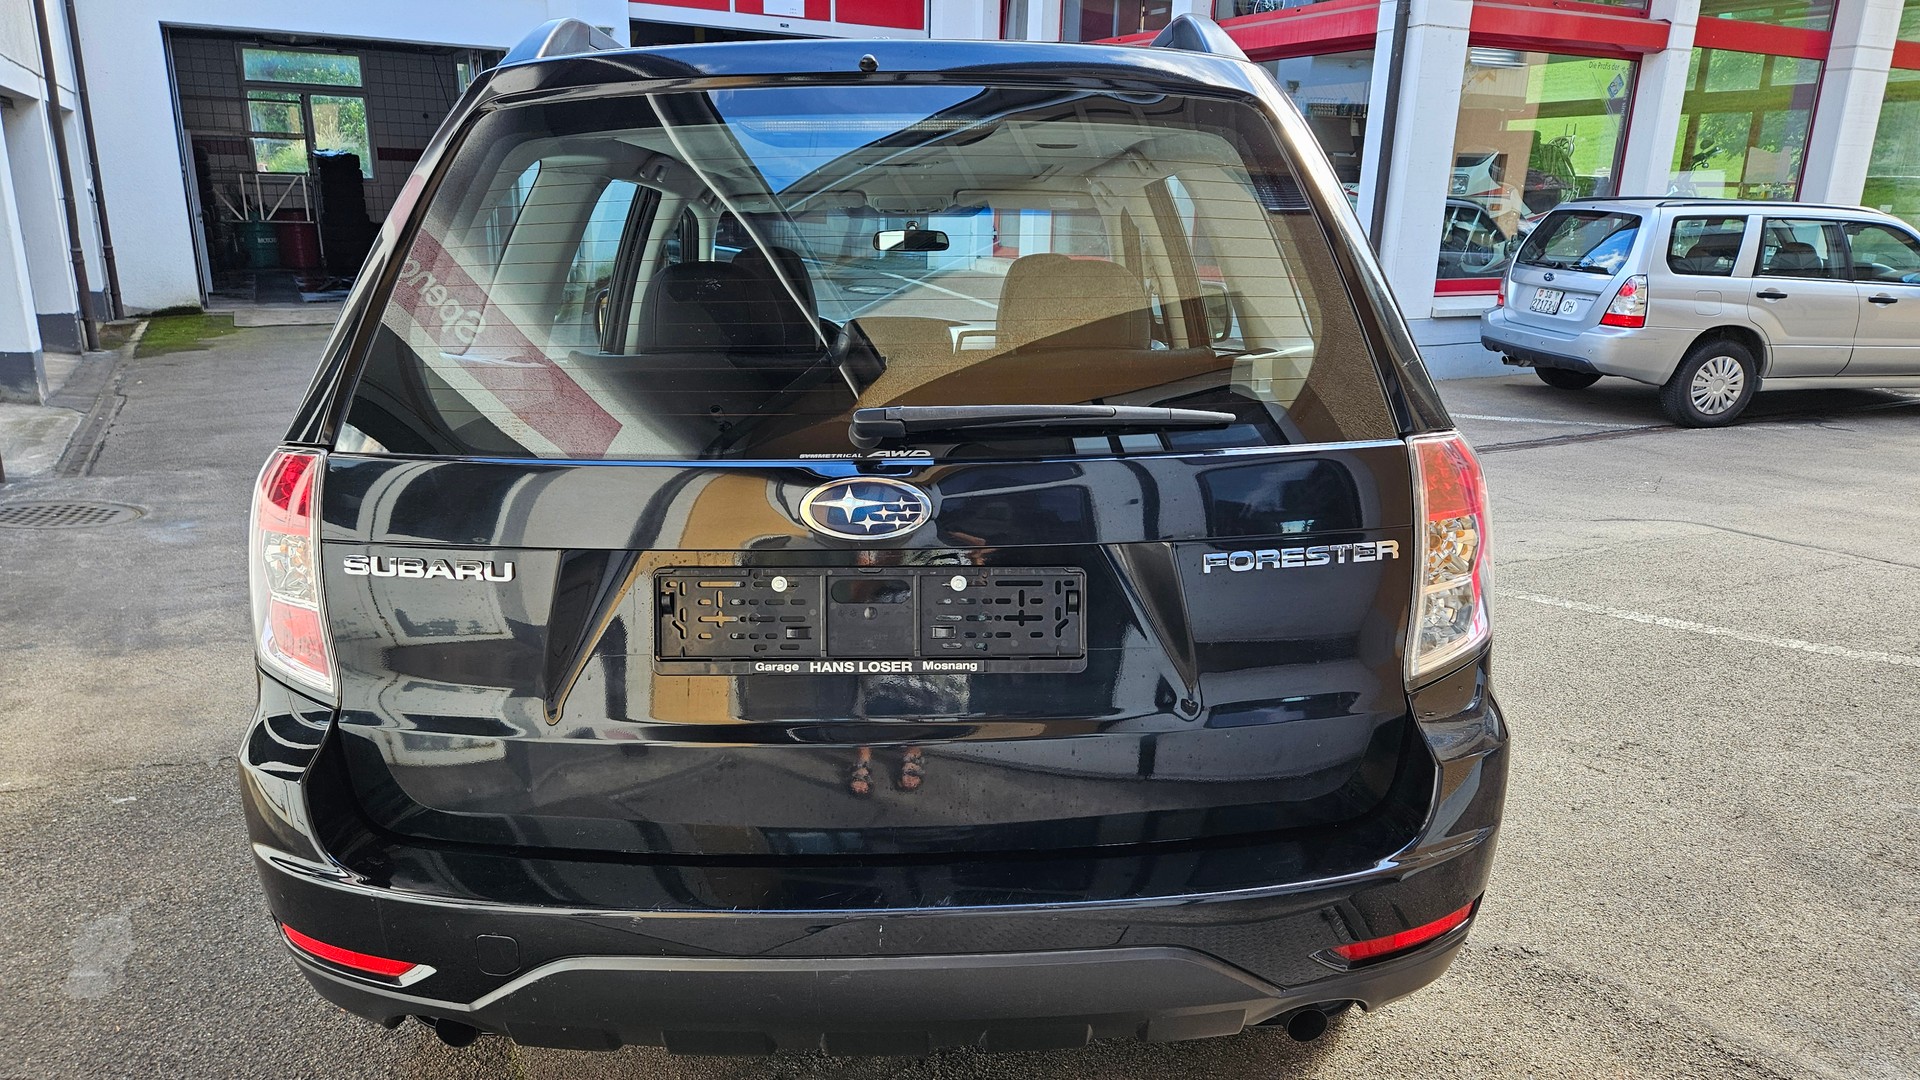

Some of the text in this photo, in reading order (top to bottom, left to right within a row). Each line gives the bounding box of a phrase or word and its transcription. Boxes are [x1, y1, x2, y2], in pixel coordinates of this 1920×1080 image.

[1545, 290, 1553, 299] SG
[1563, 300, 1575, 313] CH
[867, 450, 931, 458] AWD
[1203, 540, 1400, 573] FORESTER
[343, 554, 516, 583] SUBARU
[755, 661, 978, 673] Garage HANS LOSER Mosnang
